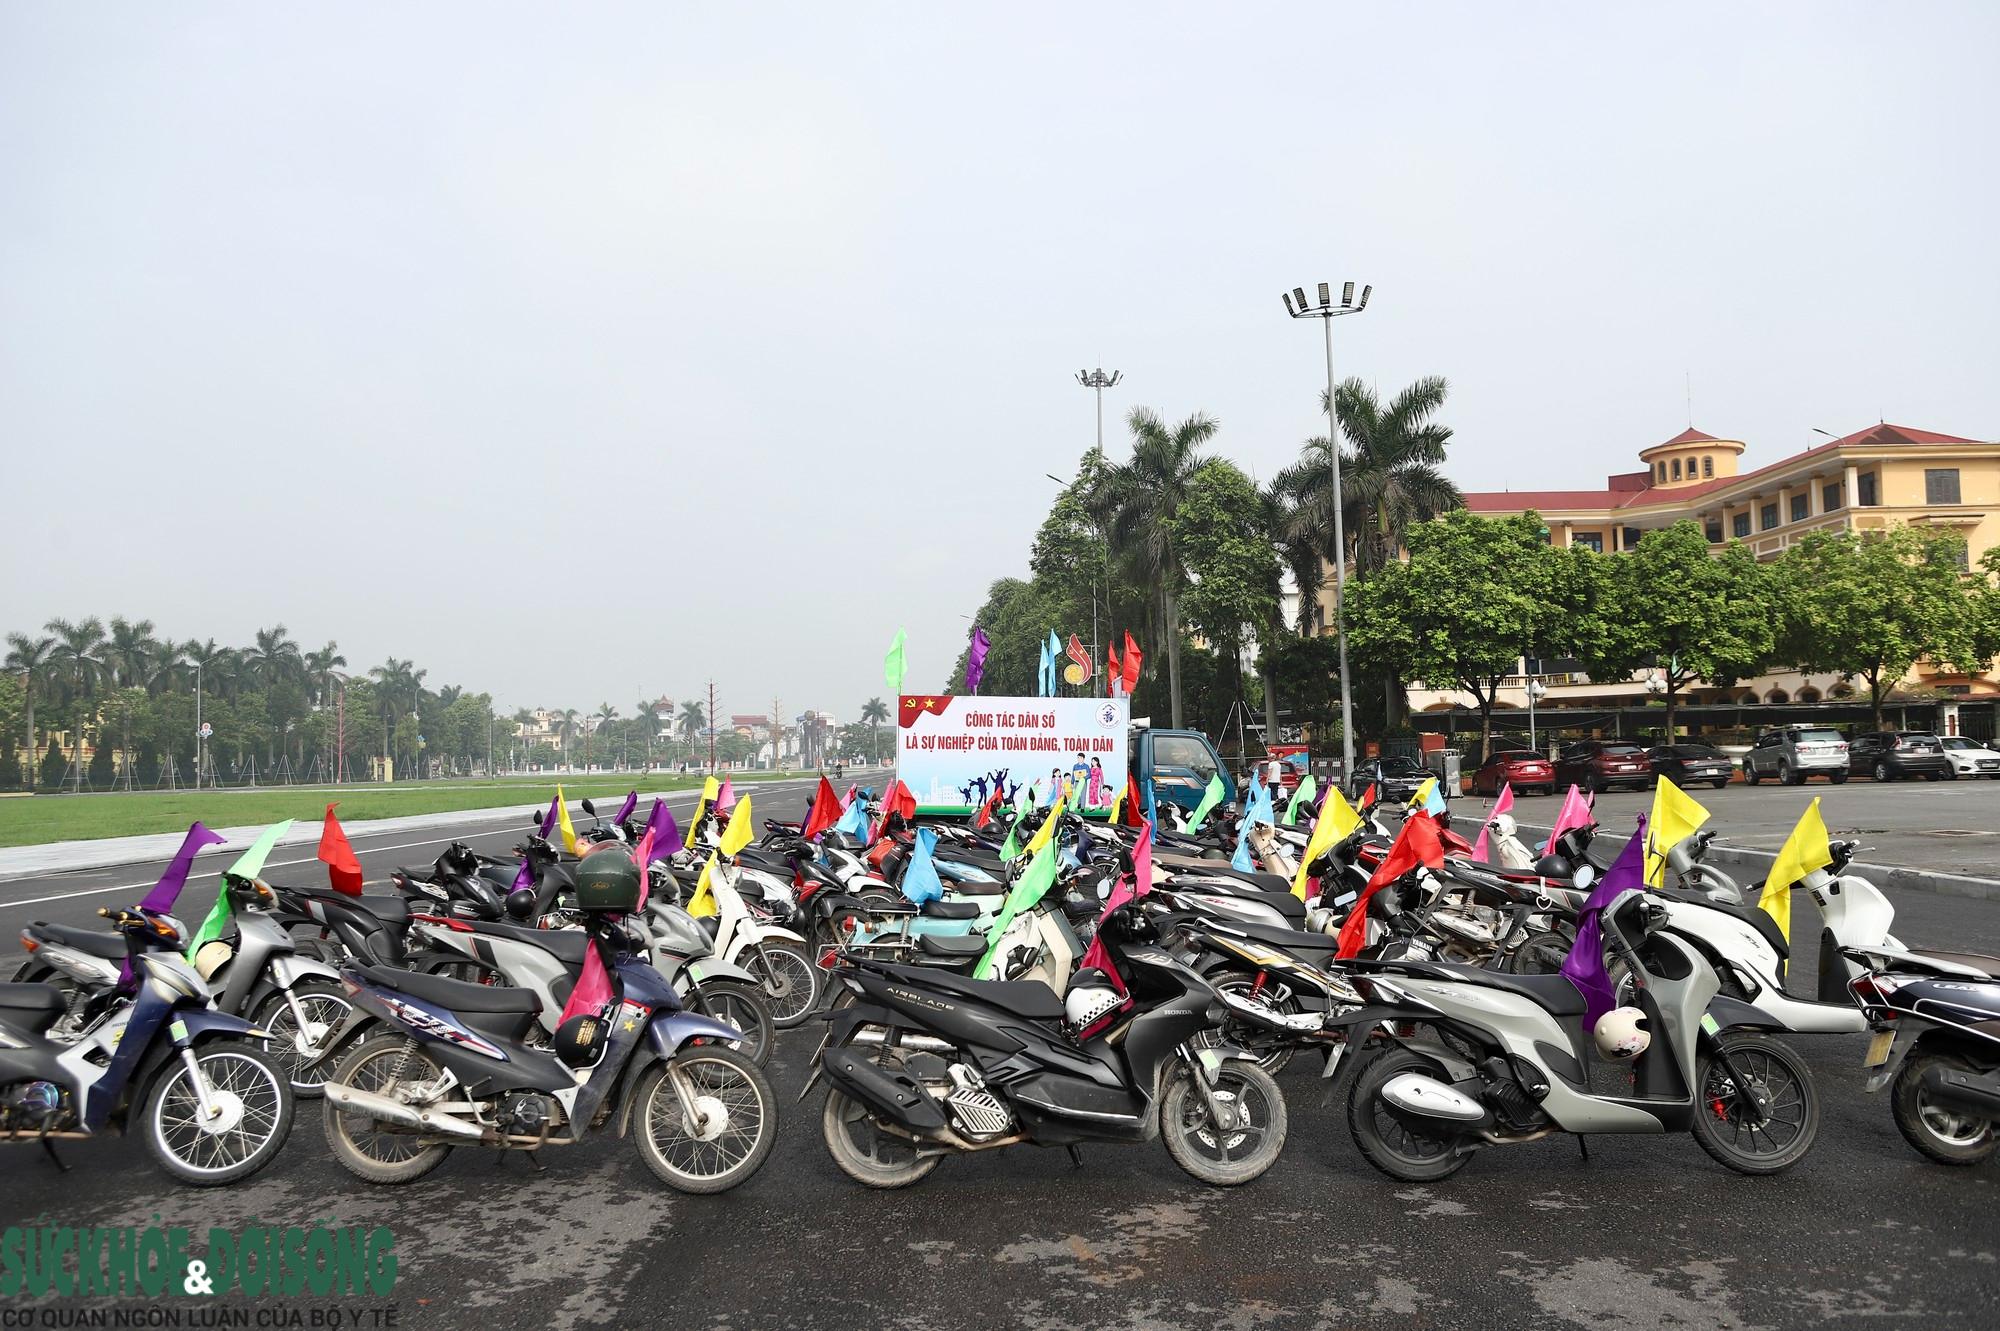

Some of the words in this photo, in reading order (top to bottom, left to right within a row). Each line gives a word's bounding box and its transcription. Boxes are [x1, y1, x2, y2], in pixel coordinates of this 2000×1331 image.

[965, 710, 993, 728] CÔNG
[996, 711, 1015, 728] TÁC
[1018, 711, 1039, 728] DÂN
[1042, 710, 1055, 728] SỐ
[906, 733, 918, 749] LÀ
[921, 734, 936, 752] SỰ
[937, 733, 975, 753] NGHIỆP
[978, 732, 998, 750] CỦA
[1001, 734, 1027, 751] TOÀN
[1030, 733, 1061, 753] ĐẢNG,
[1064, 735, 1090, 752] TOÀN
[1093, 735, 1113, 752] DÂN
